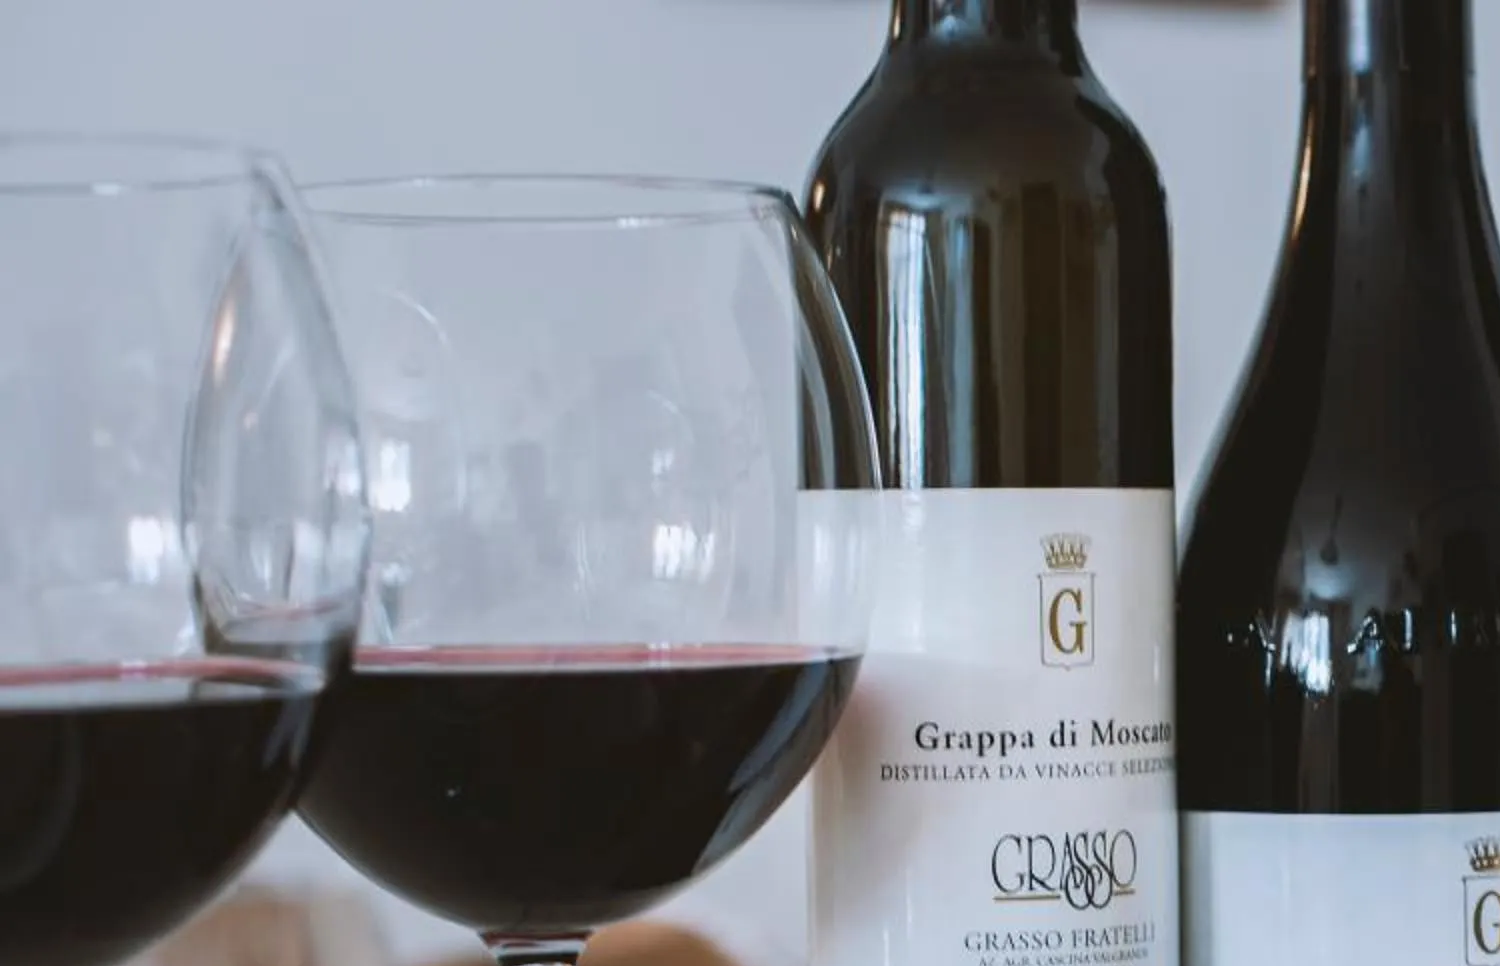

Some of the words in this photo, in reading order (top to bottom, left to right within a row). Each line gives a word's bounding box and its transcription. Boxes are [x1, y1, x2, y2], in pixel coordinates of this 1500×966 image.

[1048, 588, 1087, 655] G
[915, 721, 1035, 757] Grappa
[1050, 720, 1077, 748] di
[1091, 719, 1171, 747] Moscato
[880, 763, 989, 782] DISTILLATA
[999, 763, 1027, 781] DA
[1035, 761, 1116, 780] VINACCE
[991, 828, 1137, 911] GRASSO
[964, 929, 1064, 951] GRASSO
[1071, 922, 1156, 950] FRATELLI
